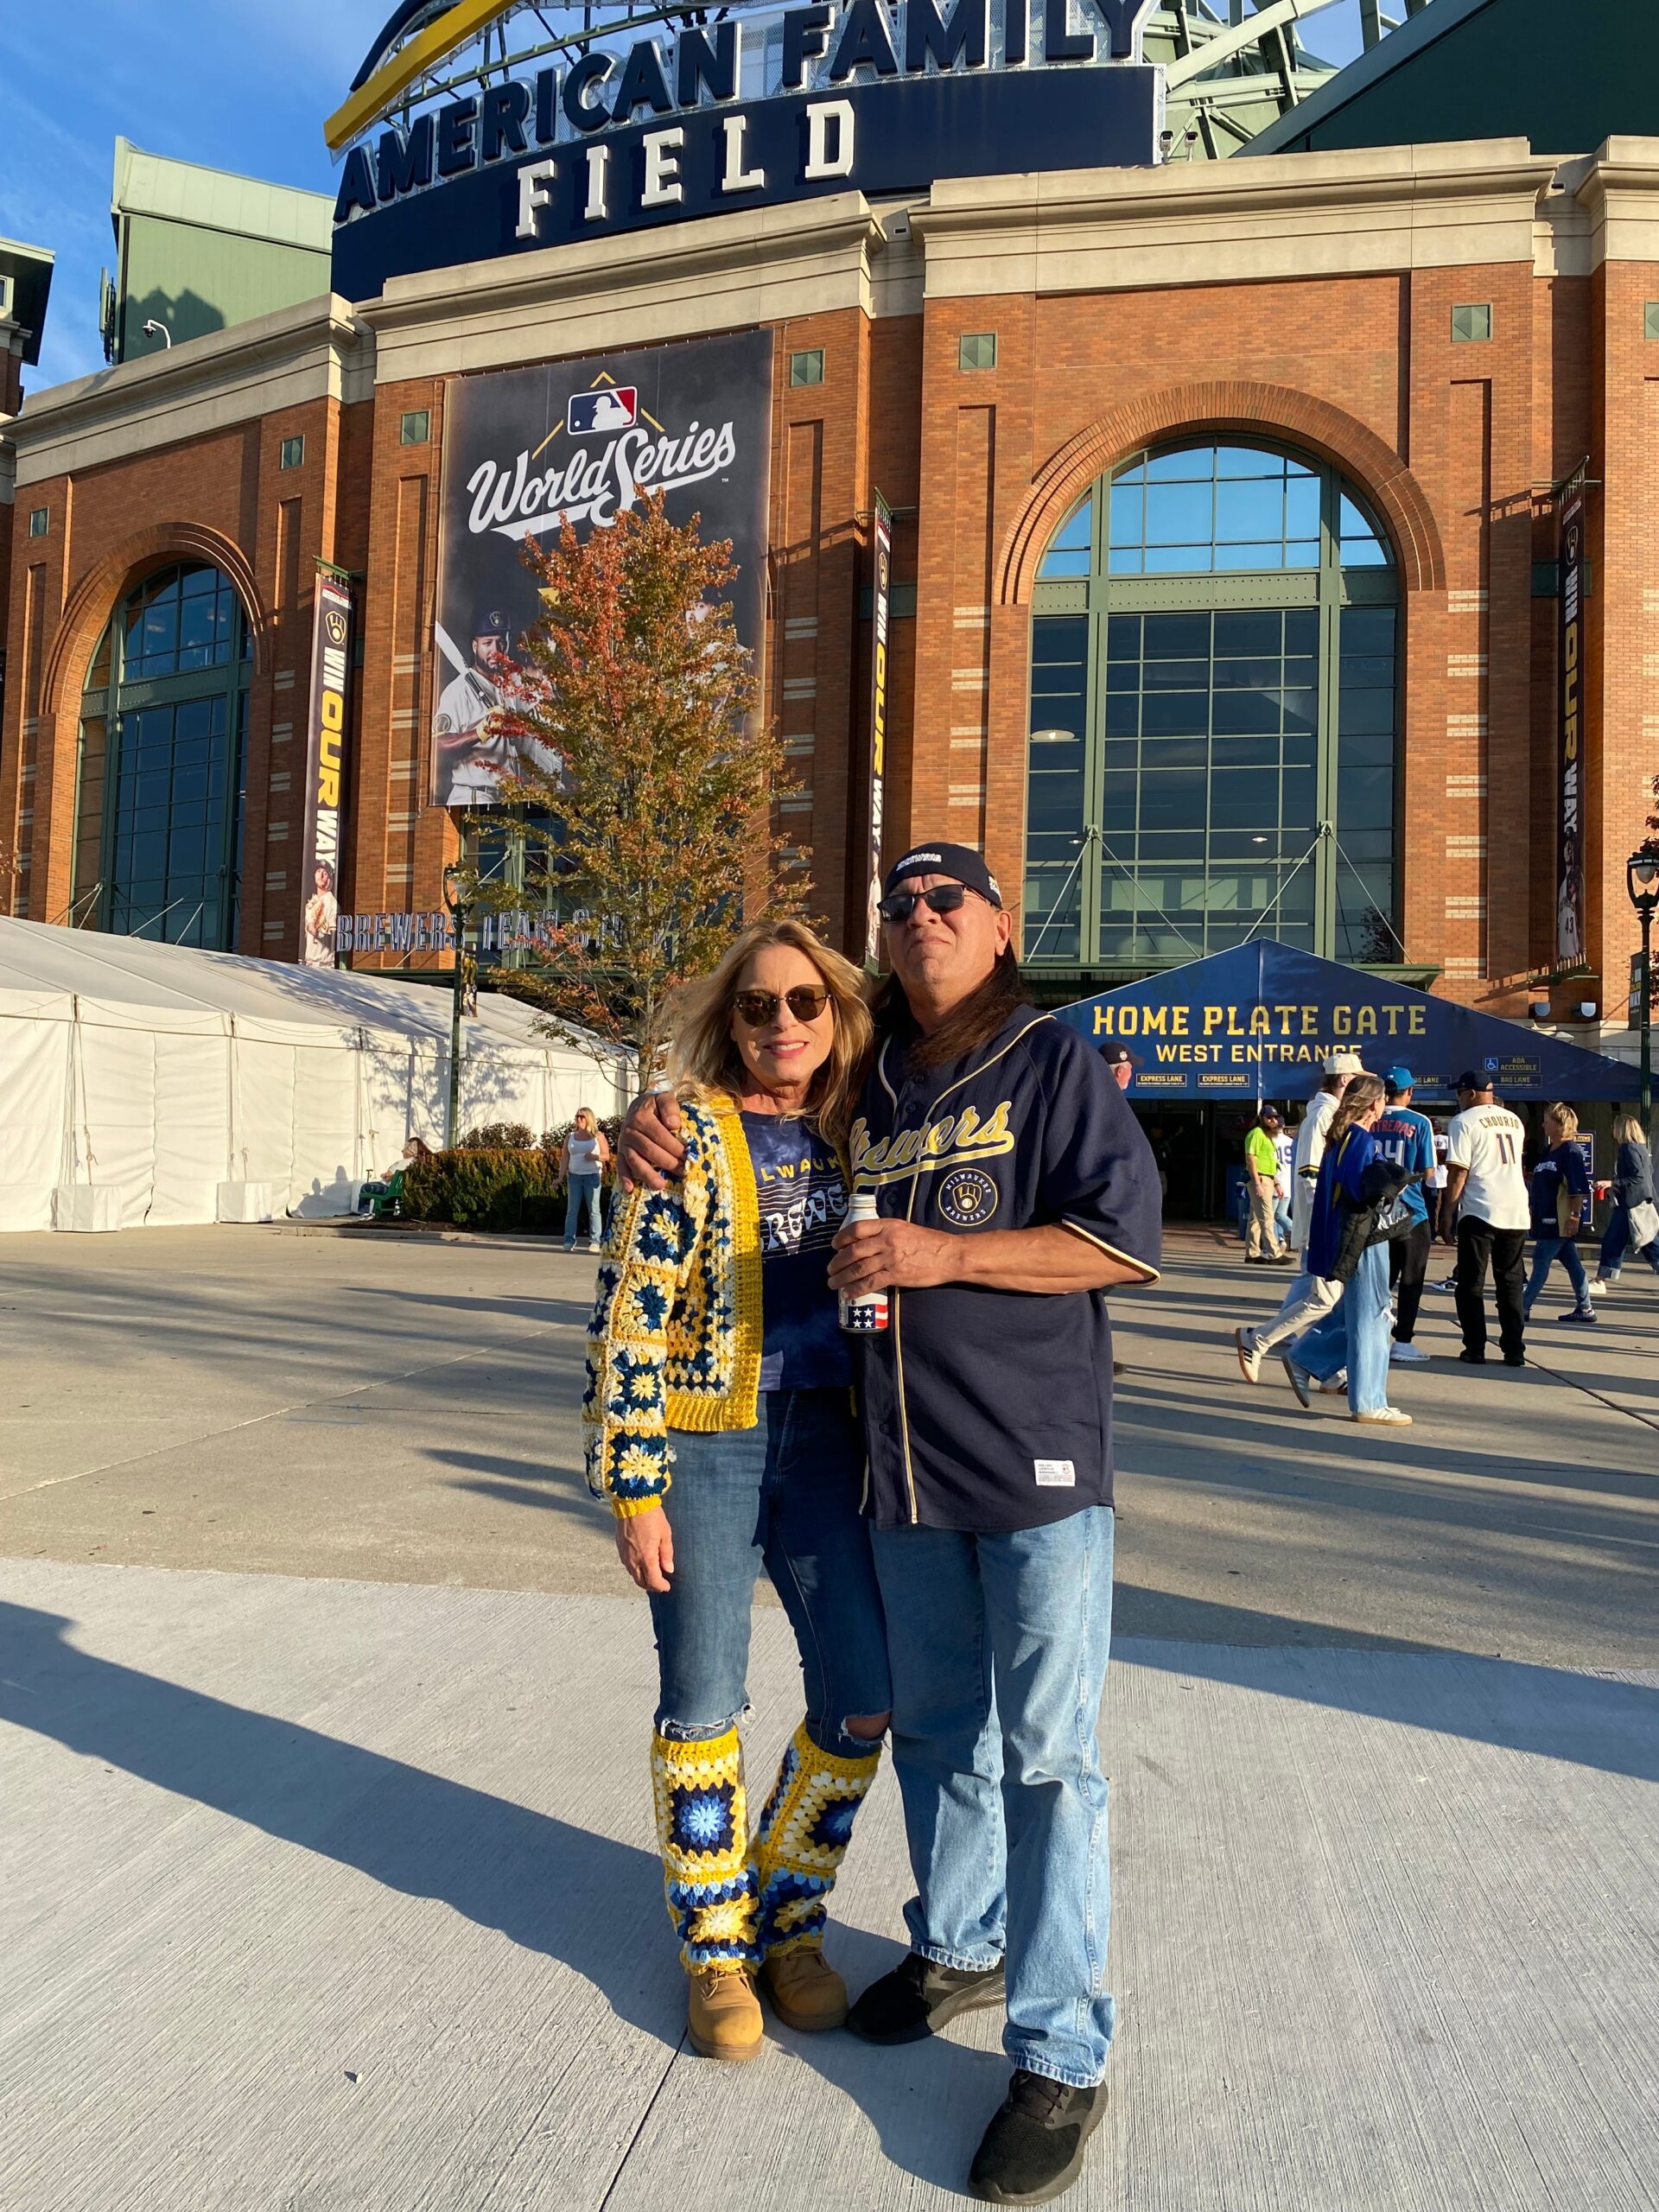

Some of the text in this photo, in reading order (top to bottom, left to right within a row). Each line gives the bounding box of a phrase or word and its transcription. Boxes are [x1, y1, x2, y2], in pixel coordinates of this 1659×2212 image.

[333, 0, 1154, 223] AMERICAN FAMILY
[515, 99, 854, 239] FIELD
[467, 421, 735, 534] World Series
[322, 646, 346, 692] WIN
[1564, 621, 1578, 766] OUR
[317, 689, 343, 808] OUR
[336, 912, 466, 951] BREWERS
[1092, 1005, 1427, 1035] HOME PLATE GATE
[1155, 1044, 1223, 1063] WEST
[1478, 1116, 1519, 1129] CHOURIO
[1277, 1146, 1293, 1164] 19
[1496, 1134, 1516, 1165] 11
[760, 1156, 840, 1182] LWAUK
[945, 1173, 992, 1193] MILWAUKEE
[945, 1205, 987, 1221] BREWERS
